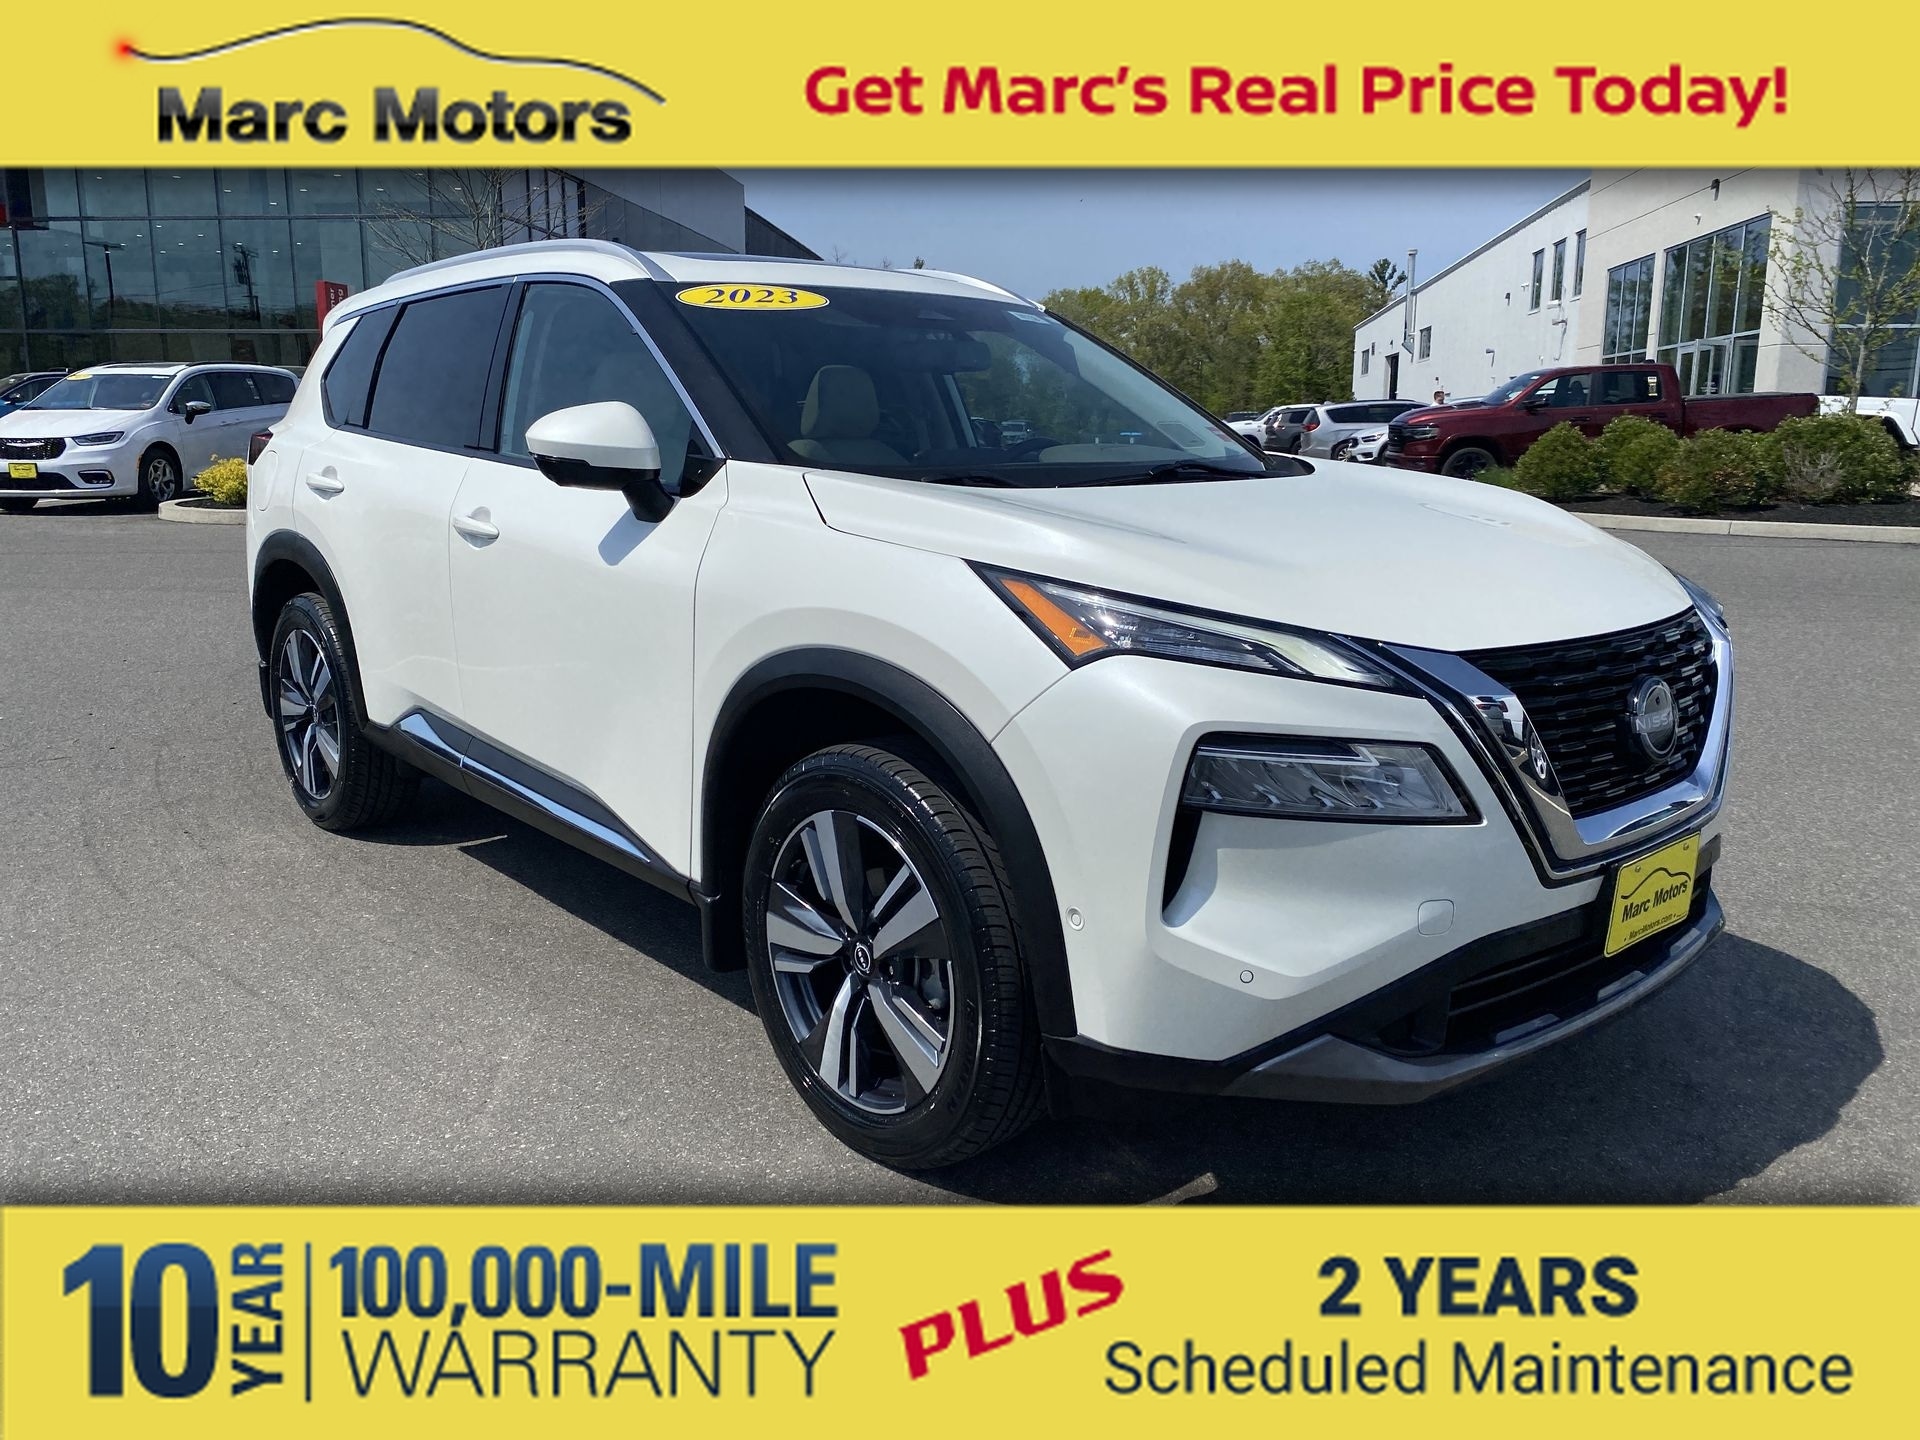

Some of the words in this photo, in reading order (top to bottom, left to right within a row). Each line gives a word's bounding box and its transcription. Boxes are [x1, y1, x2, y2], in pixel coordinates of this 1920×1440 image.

[704, 288, 798, 304] 2023
[1635, 711, 1674, 731] NISS
[1621, 899, 1650, 923] Marc
[1652, 880, 1688, 908] Motors
